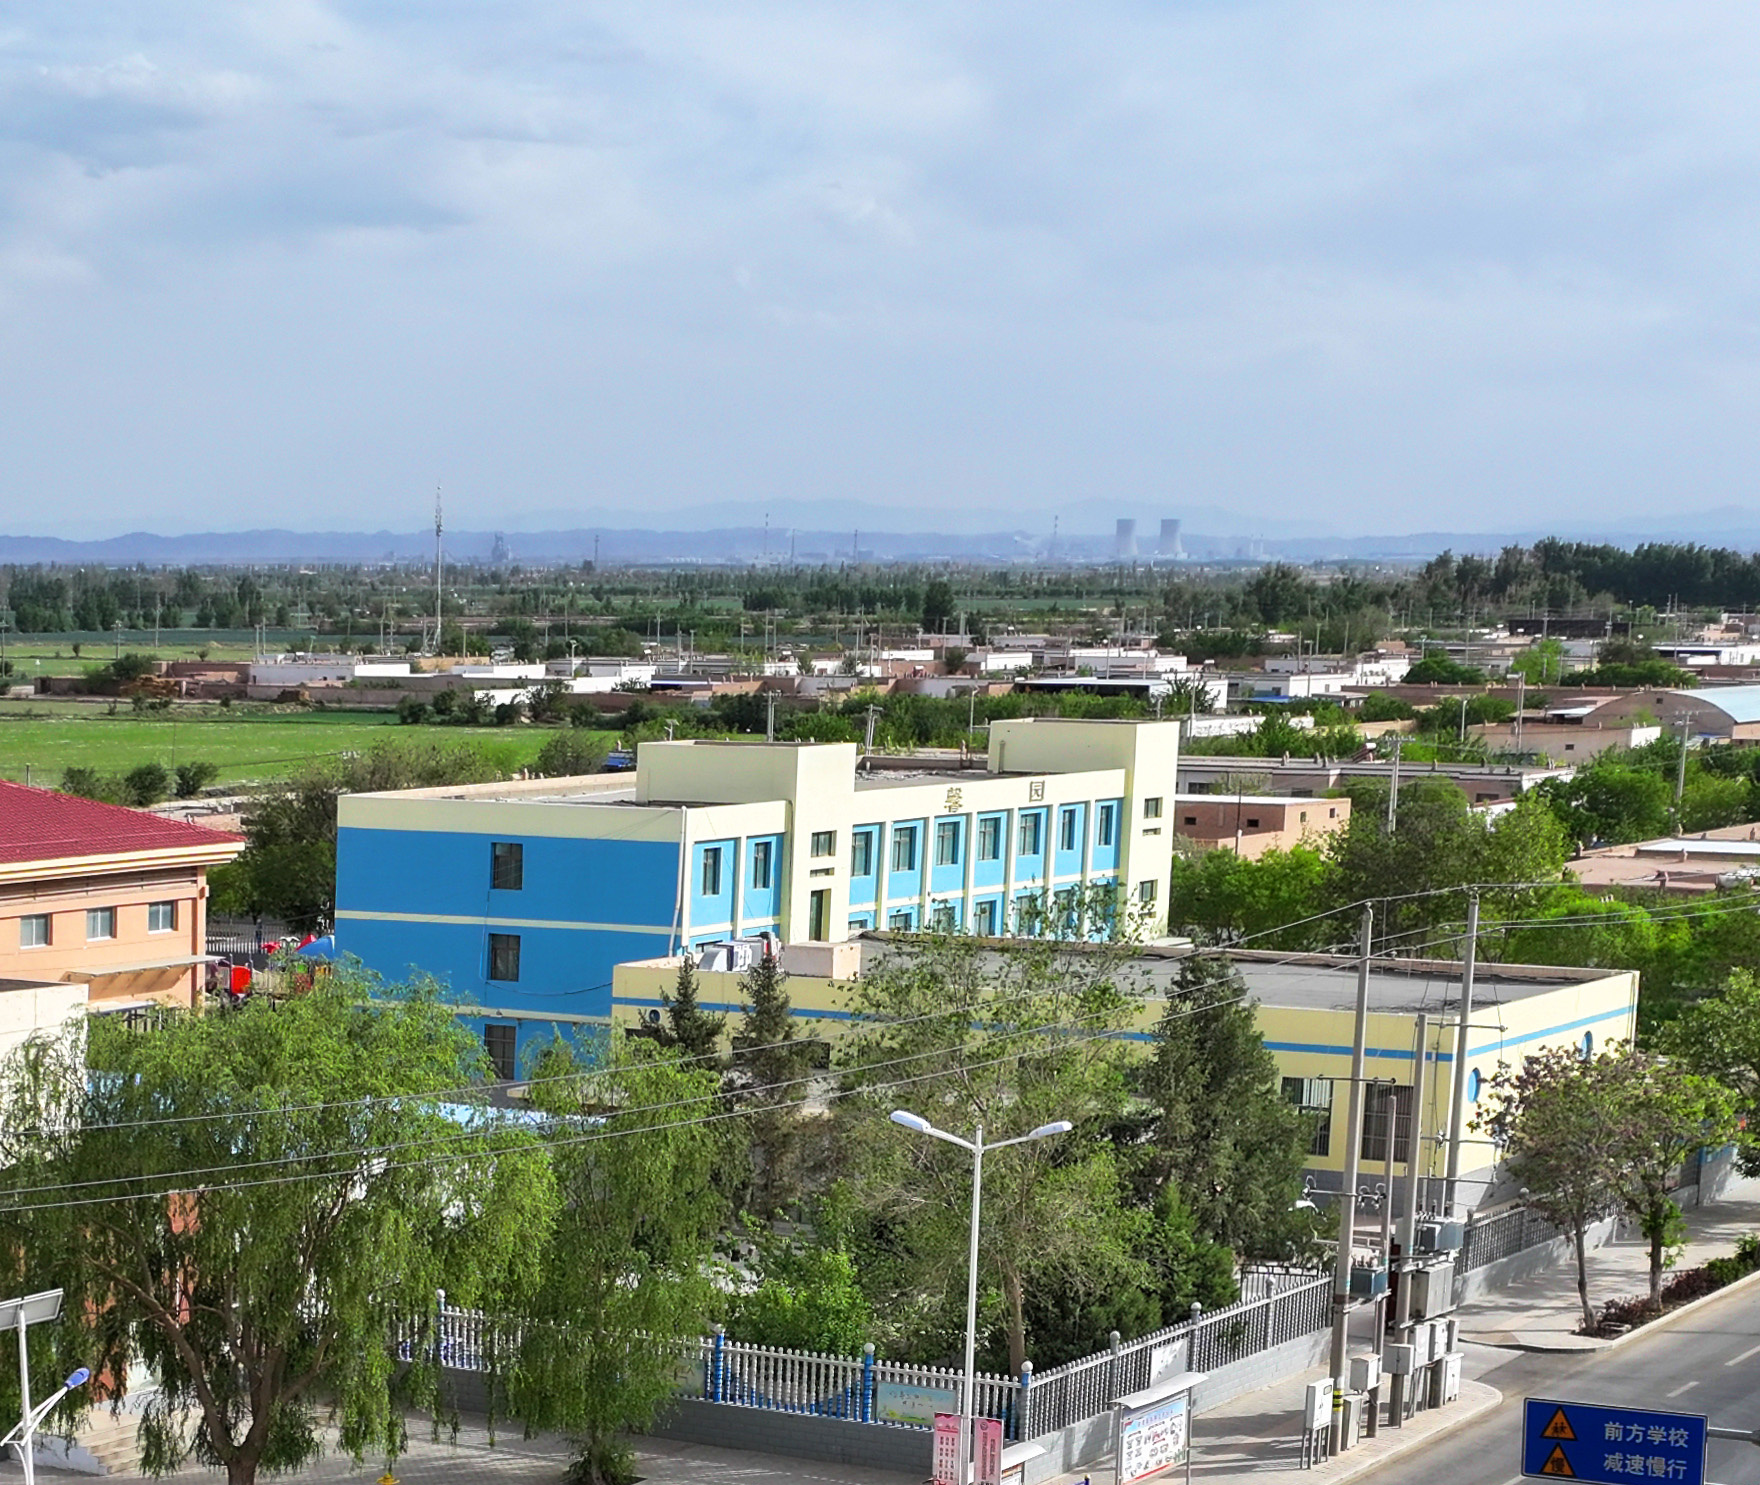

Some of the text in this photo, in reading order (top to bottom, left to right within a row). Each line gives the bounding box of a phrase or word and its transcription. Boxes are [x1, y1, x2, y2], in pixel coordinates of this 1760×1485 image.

[1604, 1421, 1689, 1448] 前方学校
[1603, 1452, 1688, 1480] 减速慢行
